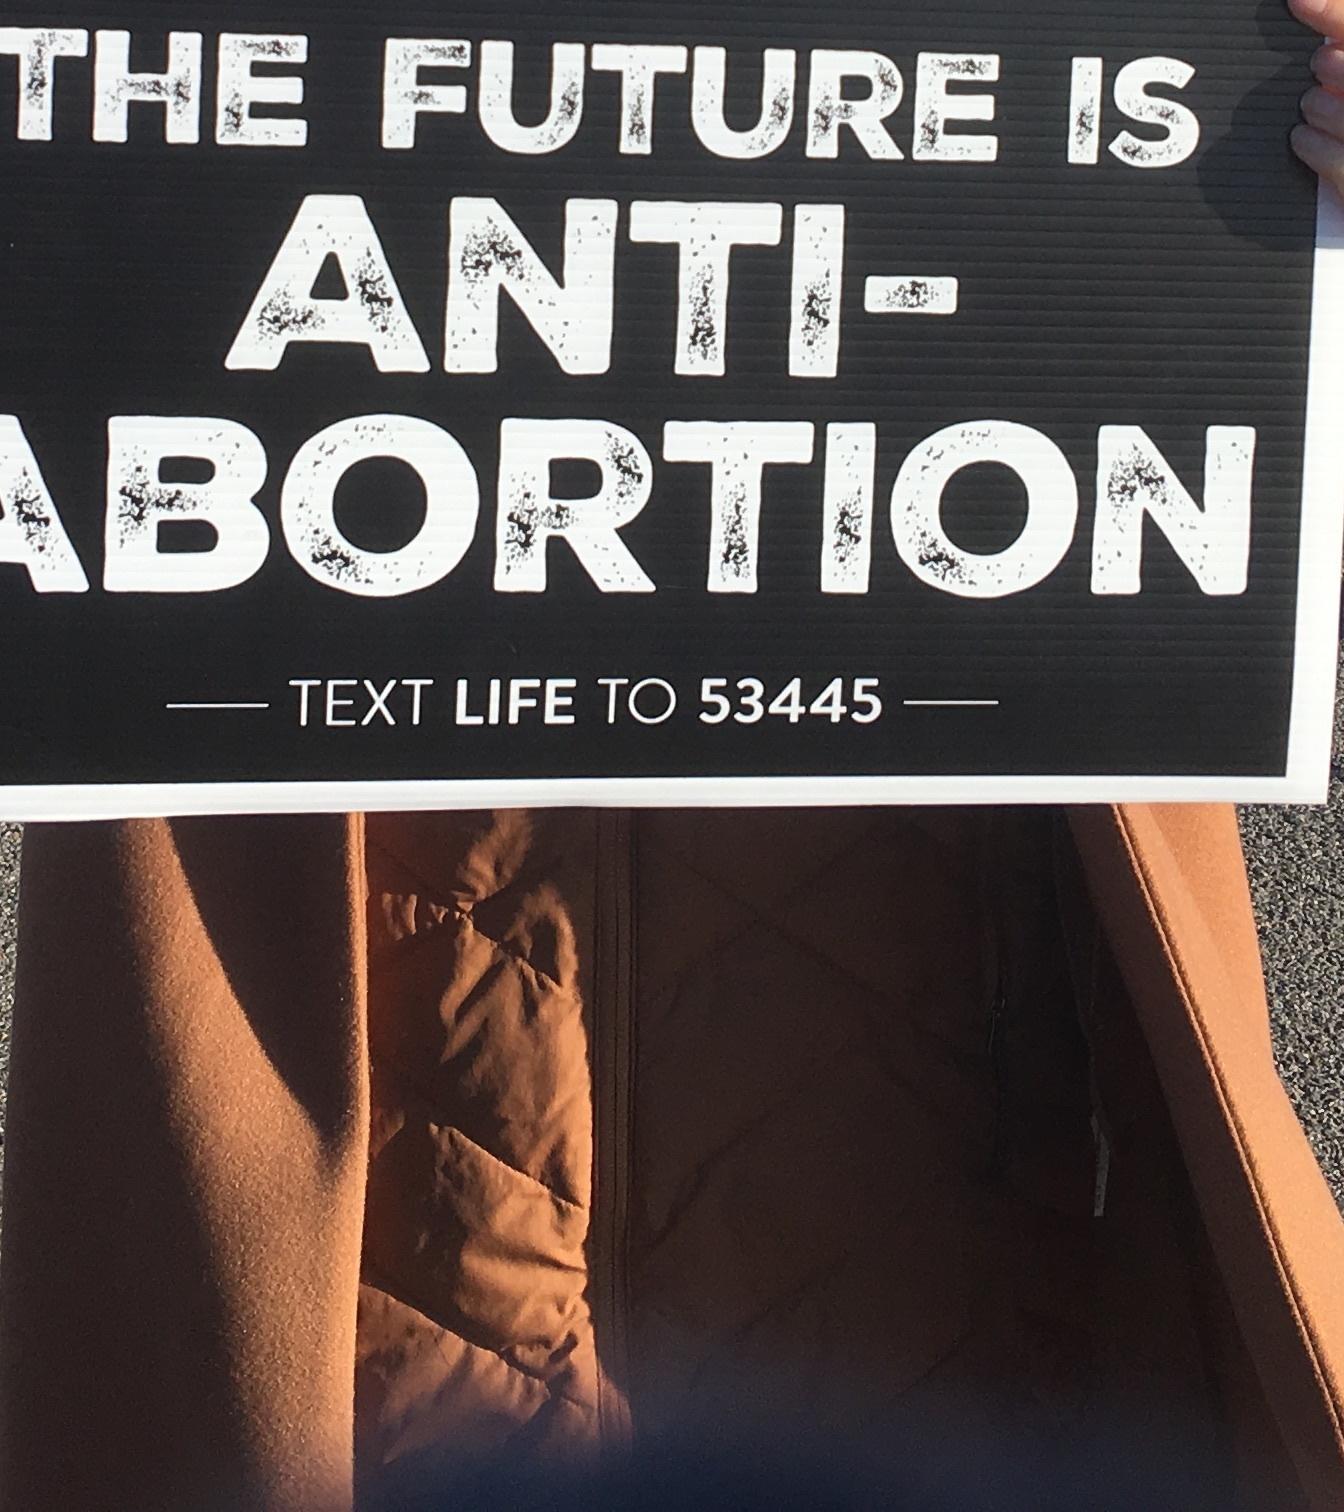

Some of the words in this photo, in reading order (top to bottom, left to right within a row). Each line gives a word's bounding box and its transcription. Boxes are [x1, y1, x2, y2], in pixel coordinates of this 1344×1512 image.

[381, 37, 1000, 162] FUTURE
[1067, 56, 1201, 168] IS
[223, 194, 959, 378] ANTI-
[288, 679, 434, 727] TEXT
[454, 678, 577, 726] LIFE
[597, 677, 677, 725] TO
[699, 677, 882, 725] 53445
